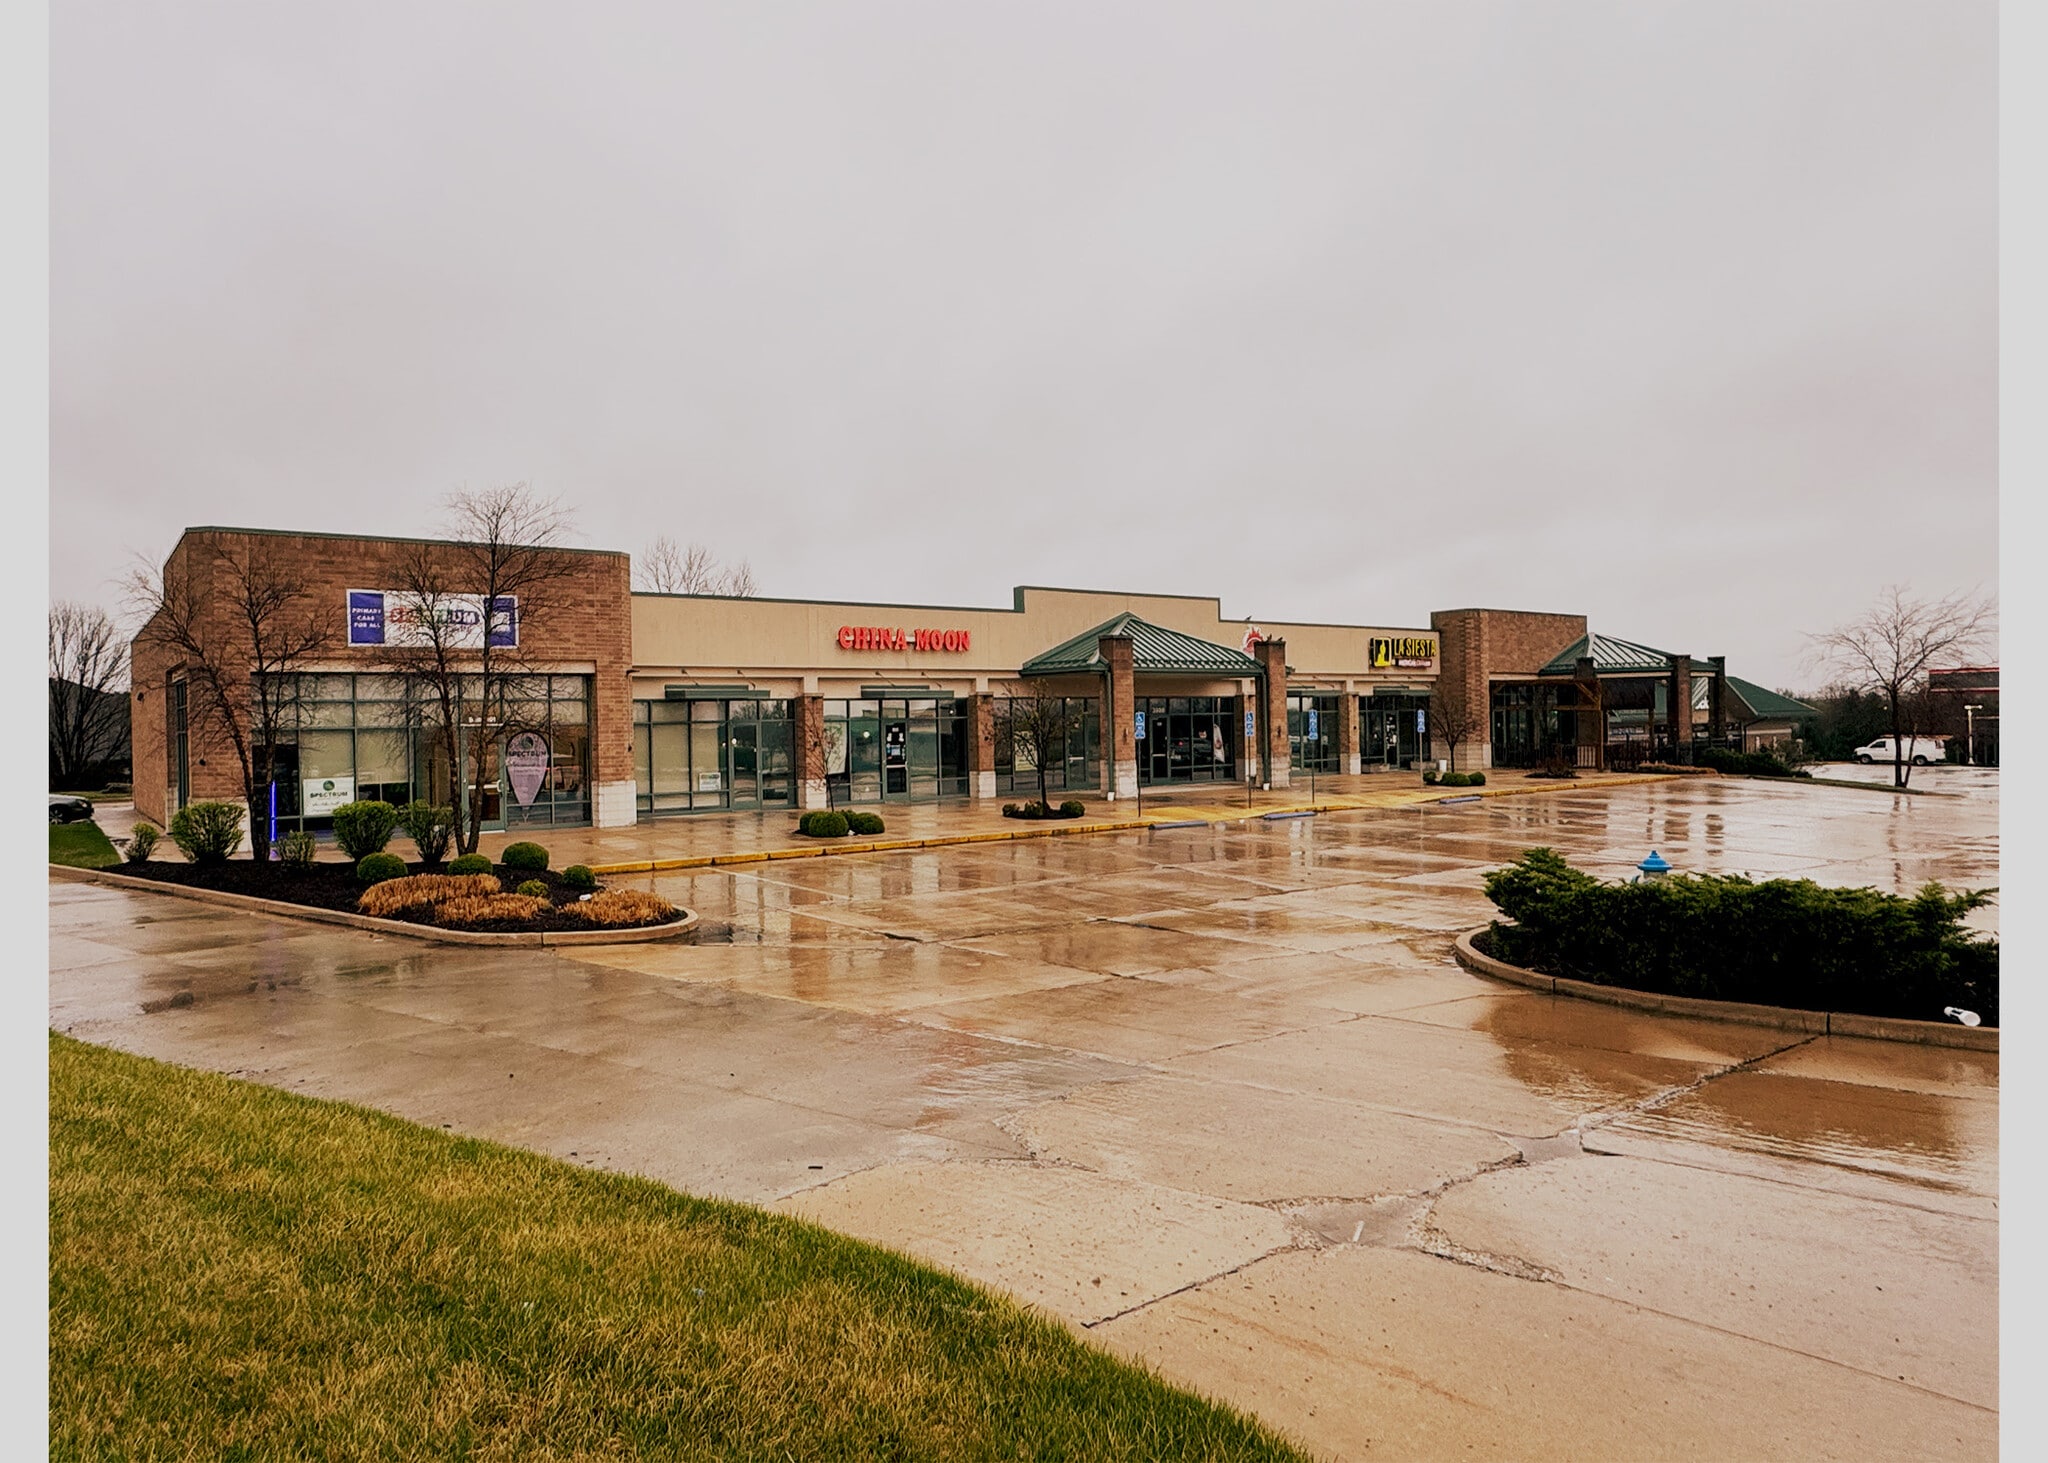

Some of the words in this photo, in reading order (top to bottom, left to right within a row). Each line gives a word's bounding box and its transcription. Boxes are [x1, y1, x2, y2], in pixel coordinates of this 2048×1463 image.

[390, 606, 479, 625] SCTUM
[369, 622, 381, 630] ALL
[837, 625, 908, 651] CHINA
[913, 628, 971, 652] MOON
[1393, 638, 1404, 657] LA
[1405, 638, 1437, 658] SIESTA
[310, 791, 348, 799] SPECTRUM
